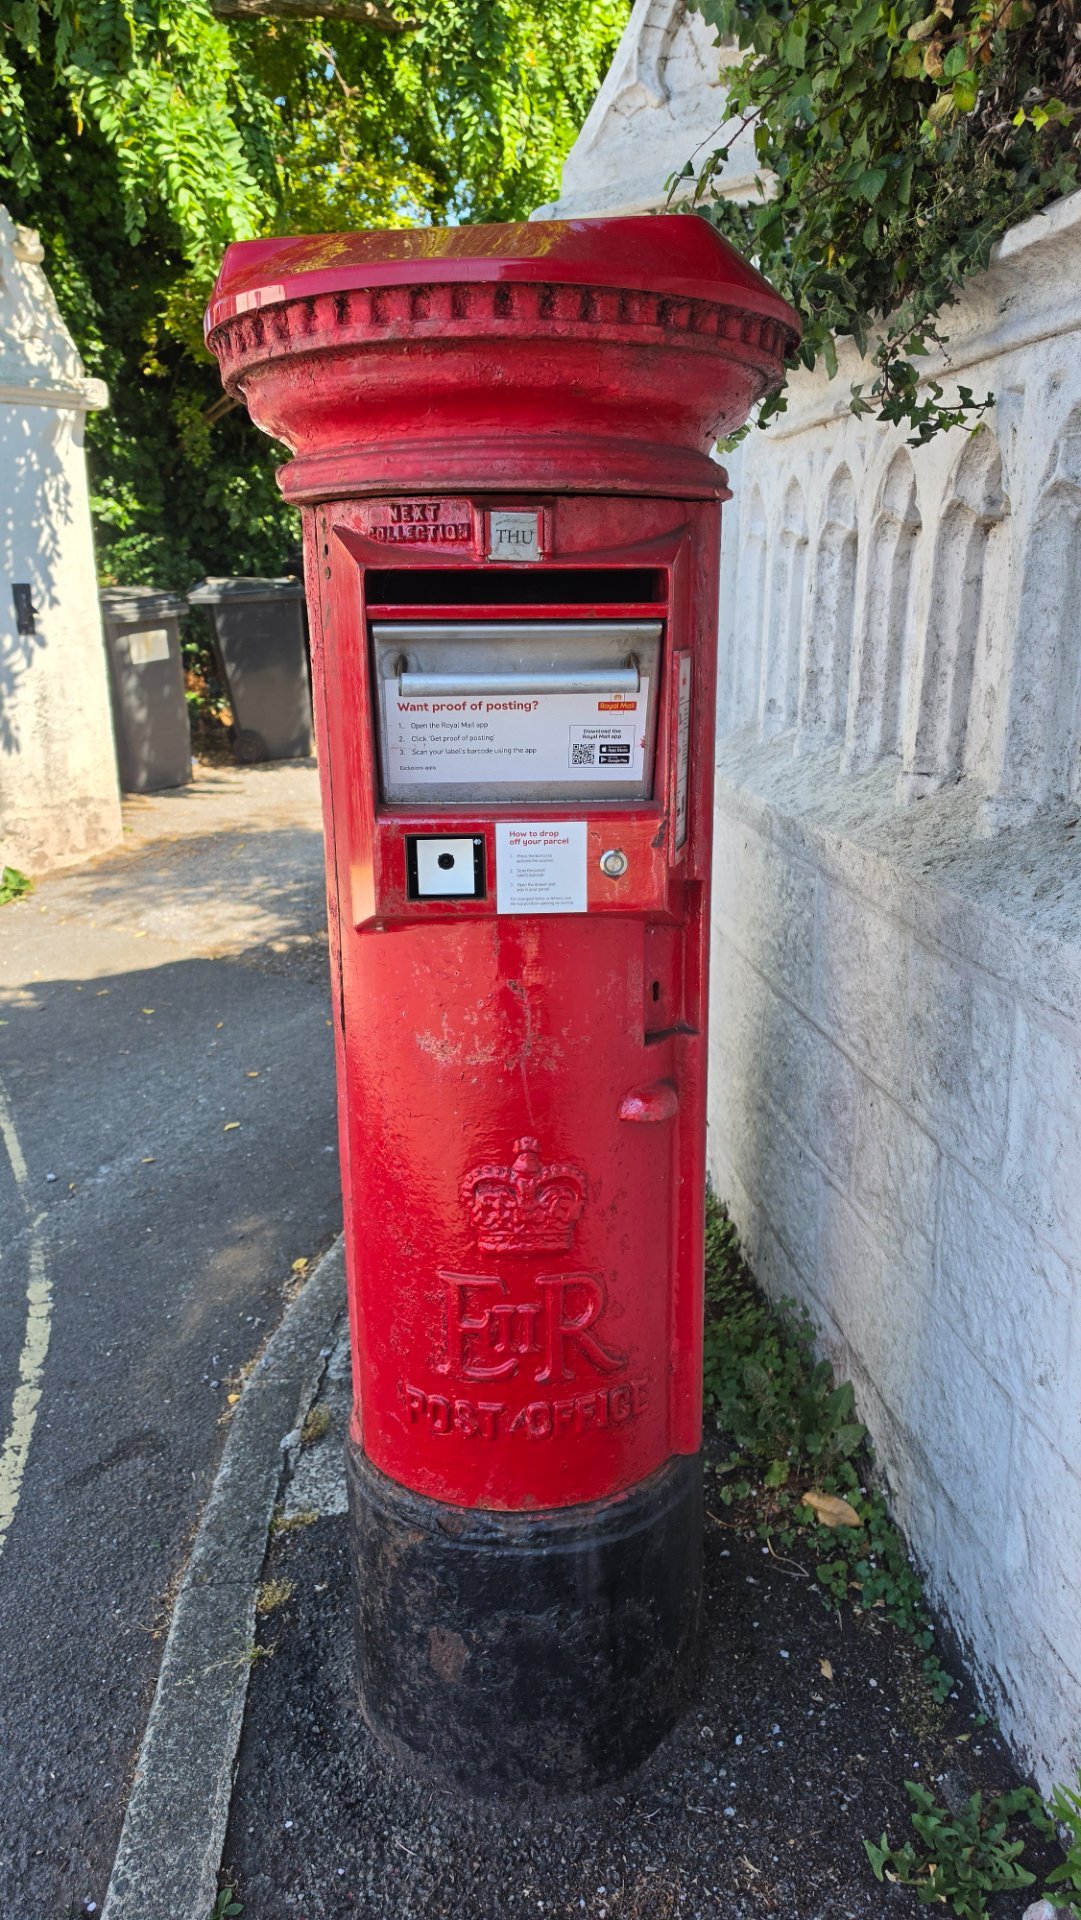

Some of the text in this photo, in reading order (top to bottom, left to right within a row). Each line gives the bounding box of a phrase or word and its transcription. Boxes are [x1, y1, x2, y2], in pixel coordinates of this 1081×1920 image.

[390, 503, 440, 523] NEXT
[368, 523, 470, 543] COLLECTION
[496, 529, 533, 544] THU
[397, 700, 539, 713] Want proof of posting?
[600, 702, 619, 710] Royal
[410, 722, 428, 730] Open
[441, 721, 460, 730] Royal
[461, 721, 475, 729] Mail
[476, 721, 489, 729] app
[442, 734, 461, 743] proof
[461, 734, 469, 742] of
[412, 748, 428, 756] Scan
[429, 748, 444, 757] your
[467, 747, 493, 755] barcode
[494, 747, 512, 756] using
[513, 747, 523, 755] the
[525, 748, 537, 756] app
[539, 830, 559, 838] drop
[509, 838, 521, 846] off
[543, 838, 569, 846] parcel
[404, 1378, 650, 1440] POST OFFICE
